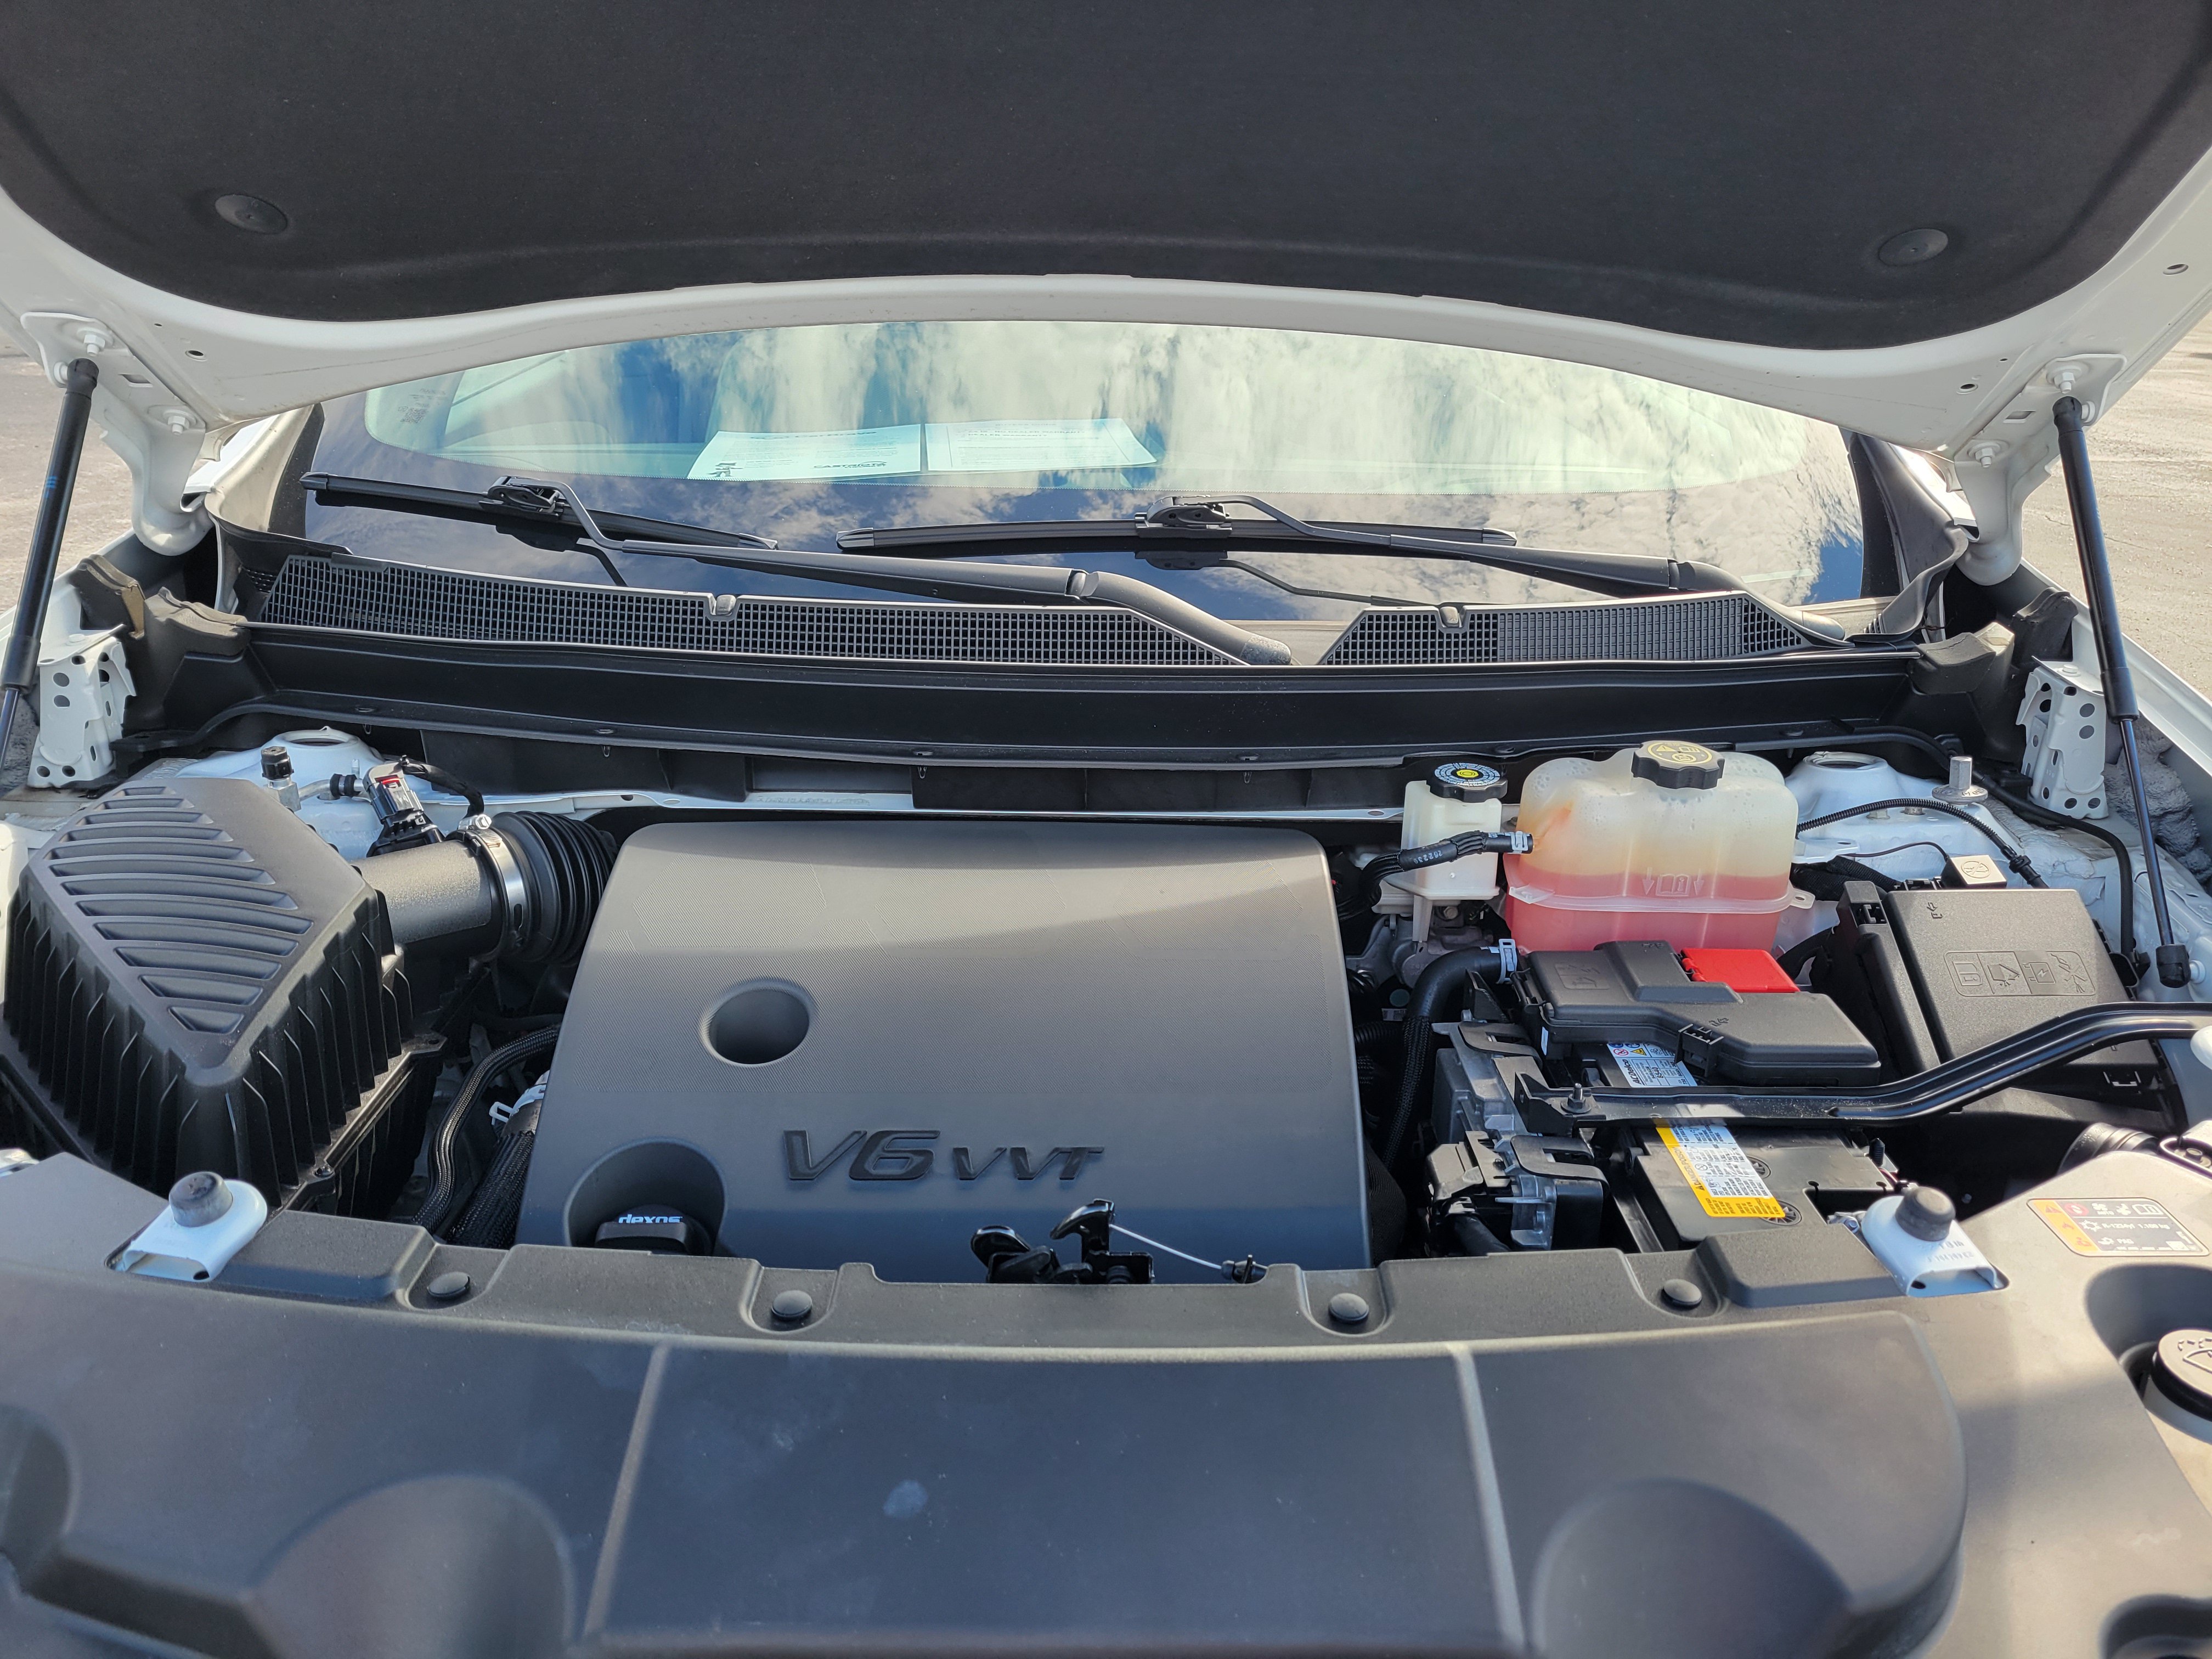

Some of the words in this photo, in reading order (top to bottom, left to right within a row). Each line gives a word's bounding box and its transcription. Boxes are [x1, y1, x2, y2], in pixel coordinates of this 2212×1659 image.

[1622, 1059, 1642, 1085] ACDelco
[783, 1130, 940, 1180] V6
[953, 1147, 1104, 1180] VVT
[618, 1214, 681, 1224] dexos
